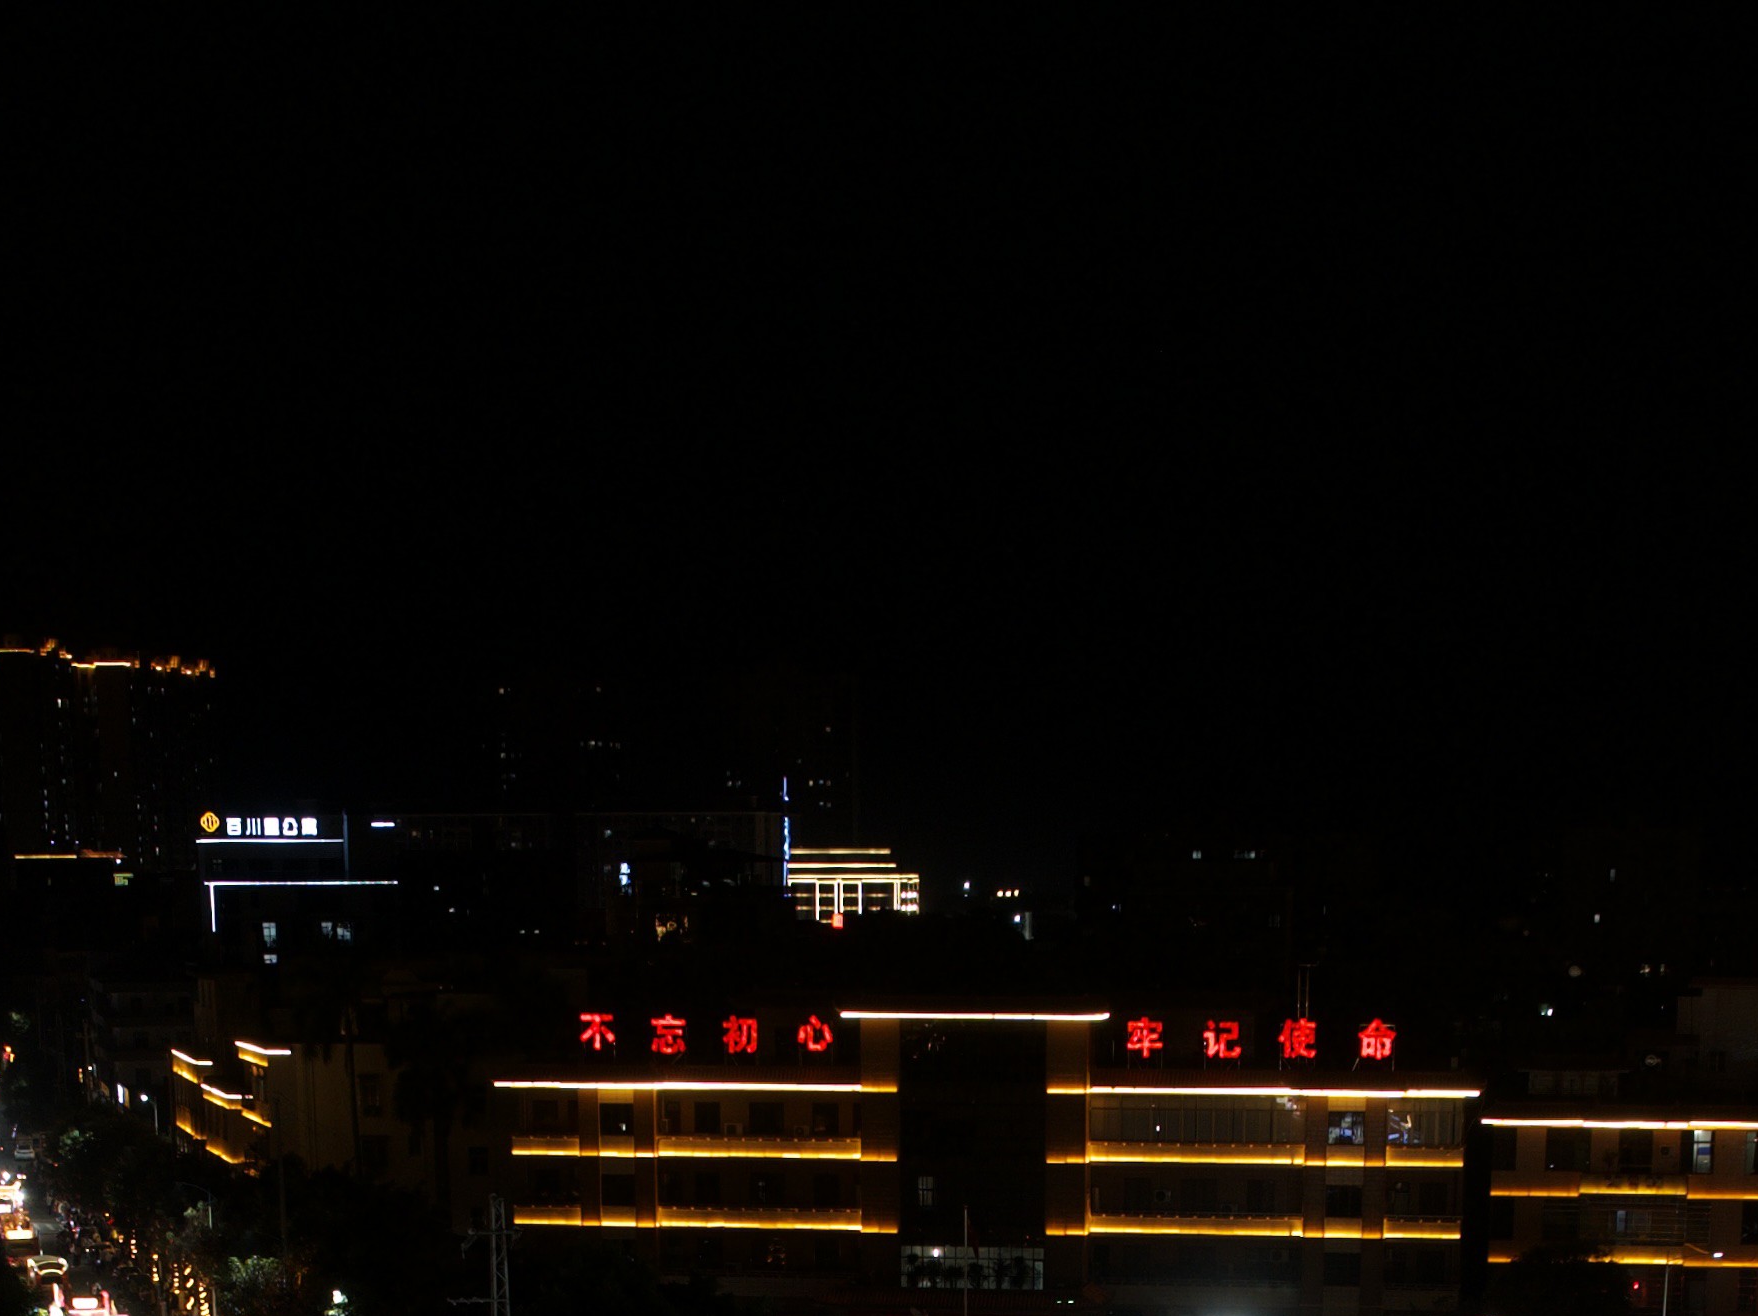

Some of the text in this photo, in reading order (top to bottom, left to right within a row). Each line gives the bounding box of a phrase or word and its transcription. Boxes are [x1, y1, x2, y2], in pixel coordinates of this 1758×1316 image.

[579, 1013, 834, 1055] 不忘初心
[1127, 1016, 1398, 1060] 牢记使命
